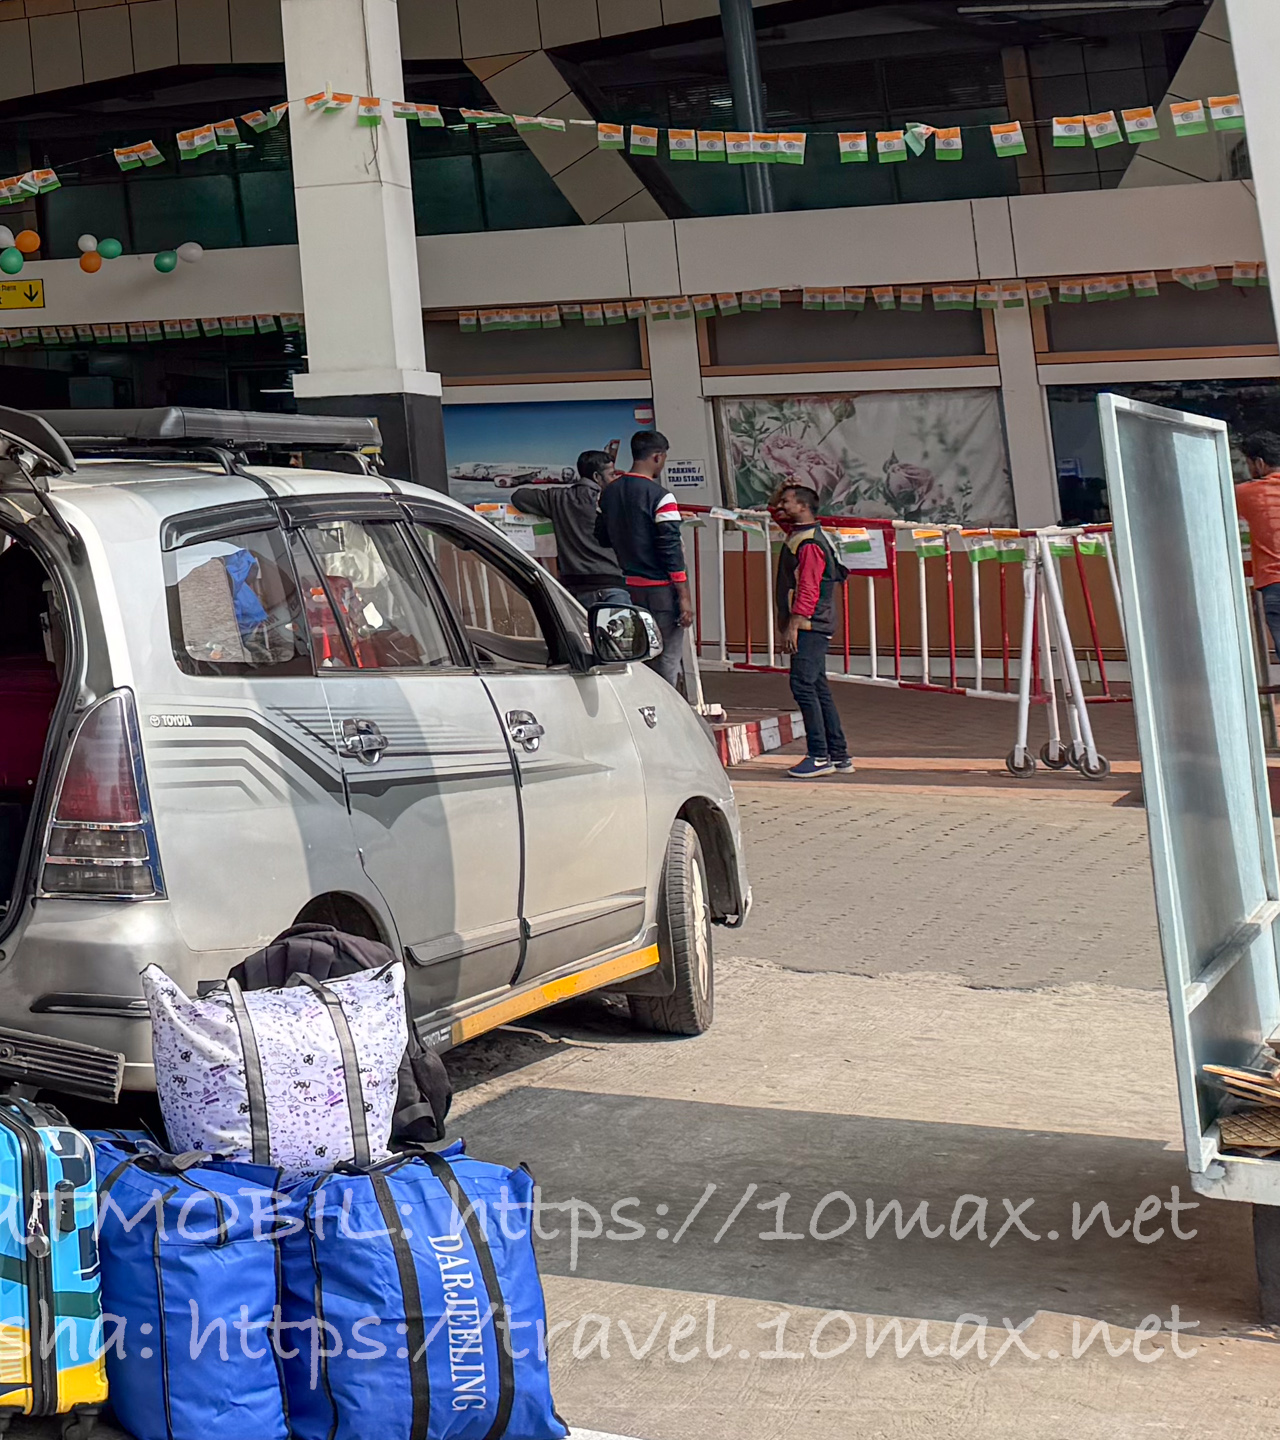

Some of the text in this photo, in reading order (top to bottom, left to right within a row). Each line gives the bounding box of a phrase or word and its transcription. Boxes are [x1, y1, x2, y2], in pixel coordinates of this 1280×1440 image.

[667, 475, 705, 483] TAXI STAND
[161, 714, 193, 727] TOYOTA
[427, 1232, 488, 1412] DARJEELING
